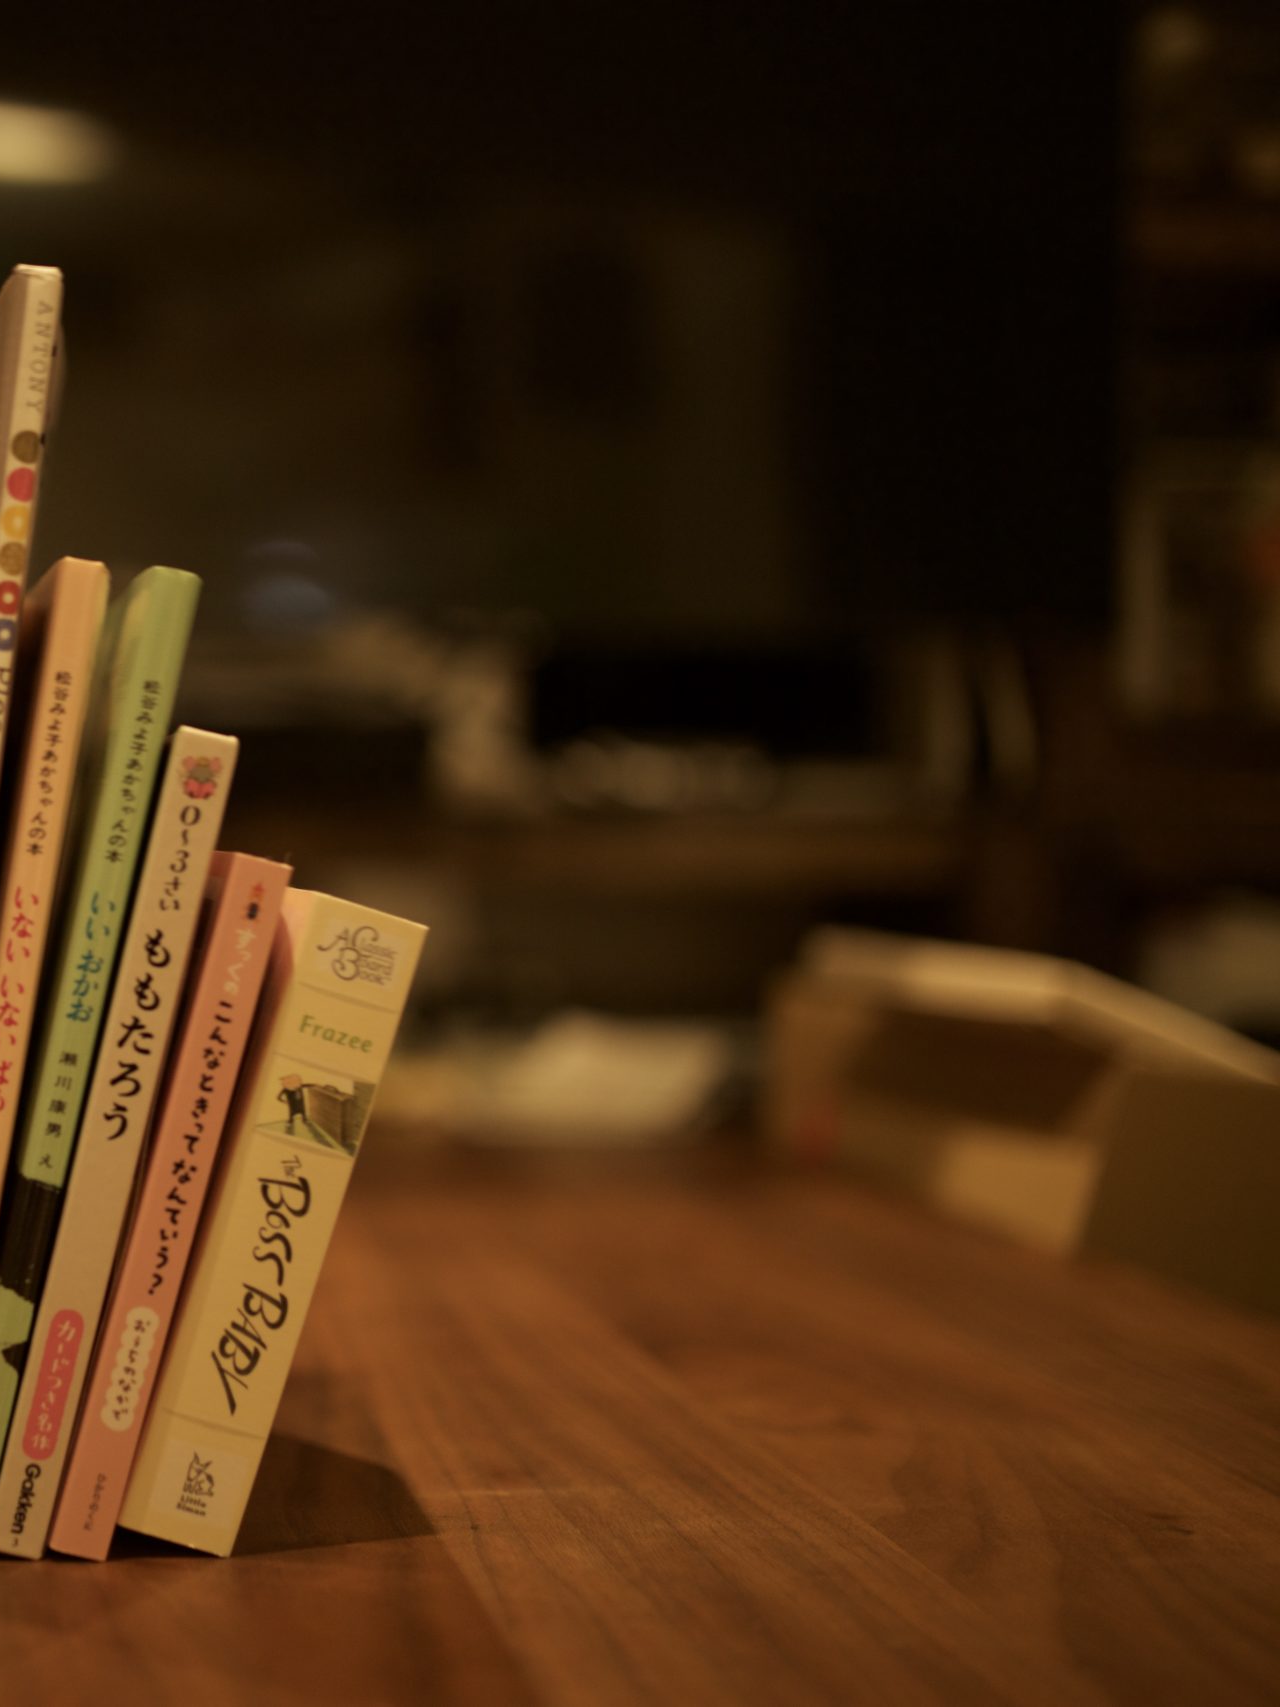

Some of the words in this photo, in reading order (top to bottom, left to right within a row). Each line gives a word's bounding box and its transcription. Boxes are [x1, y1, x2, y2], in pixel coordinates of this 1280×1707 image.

[26, 300, 53, 414] ANTONY
[103, 929, 171, 1141] ももたろう
[298, 1013, 374, 1053] Frazee
[10, 1462, 42, 1535] Gakken
